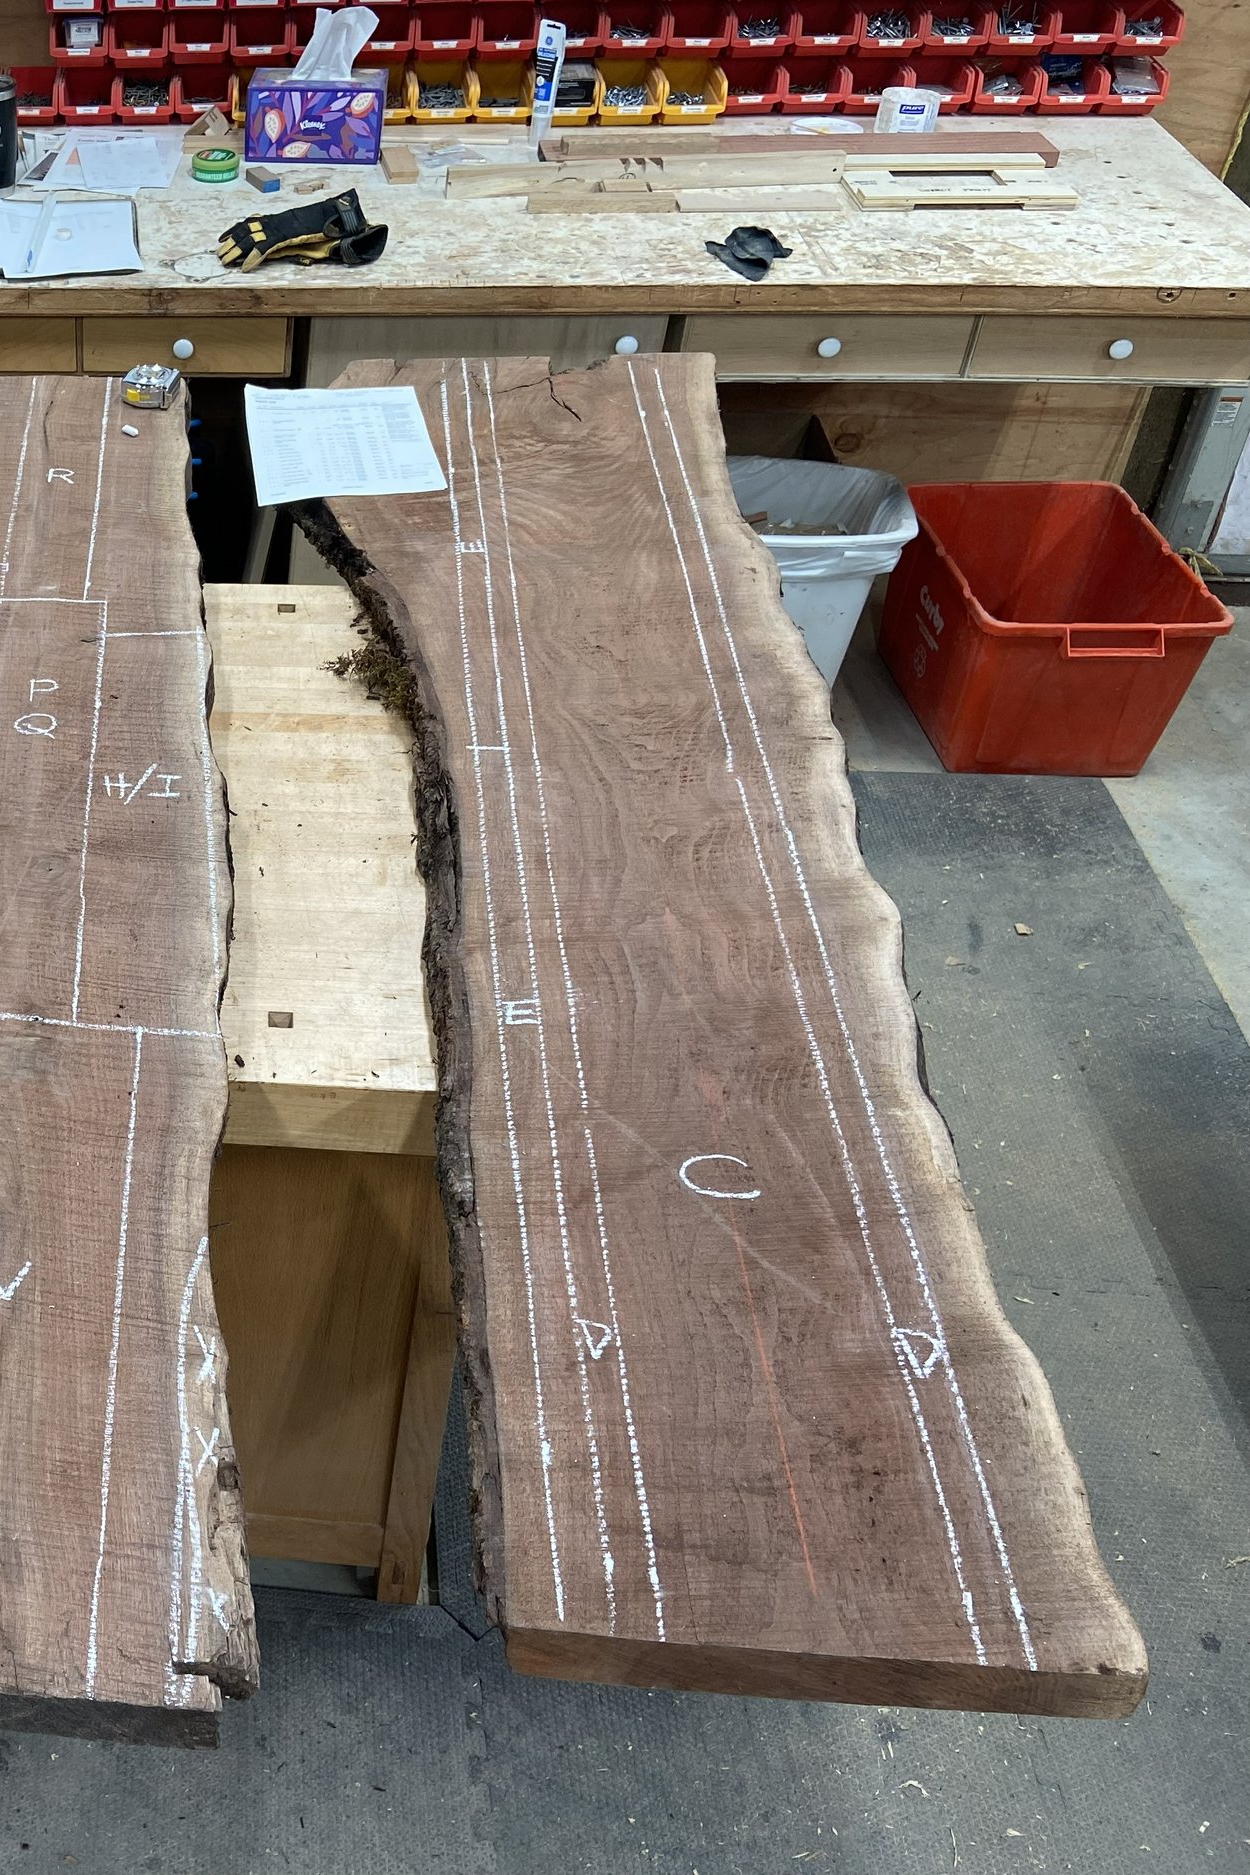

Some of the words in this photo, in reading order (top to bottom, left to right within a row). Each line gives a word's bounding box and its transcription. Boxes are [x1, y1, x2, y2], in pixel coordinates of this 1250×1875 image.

[300, 119, 326, 131] Kleenex
[46, 467, 75, 485] R
[28, 678, 60, 702] P
[13, 712, 58, 740] Q
[101, 762, 183, 806] H/I
[678, 1154, 762, 1200] C
